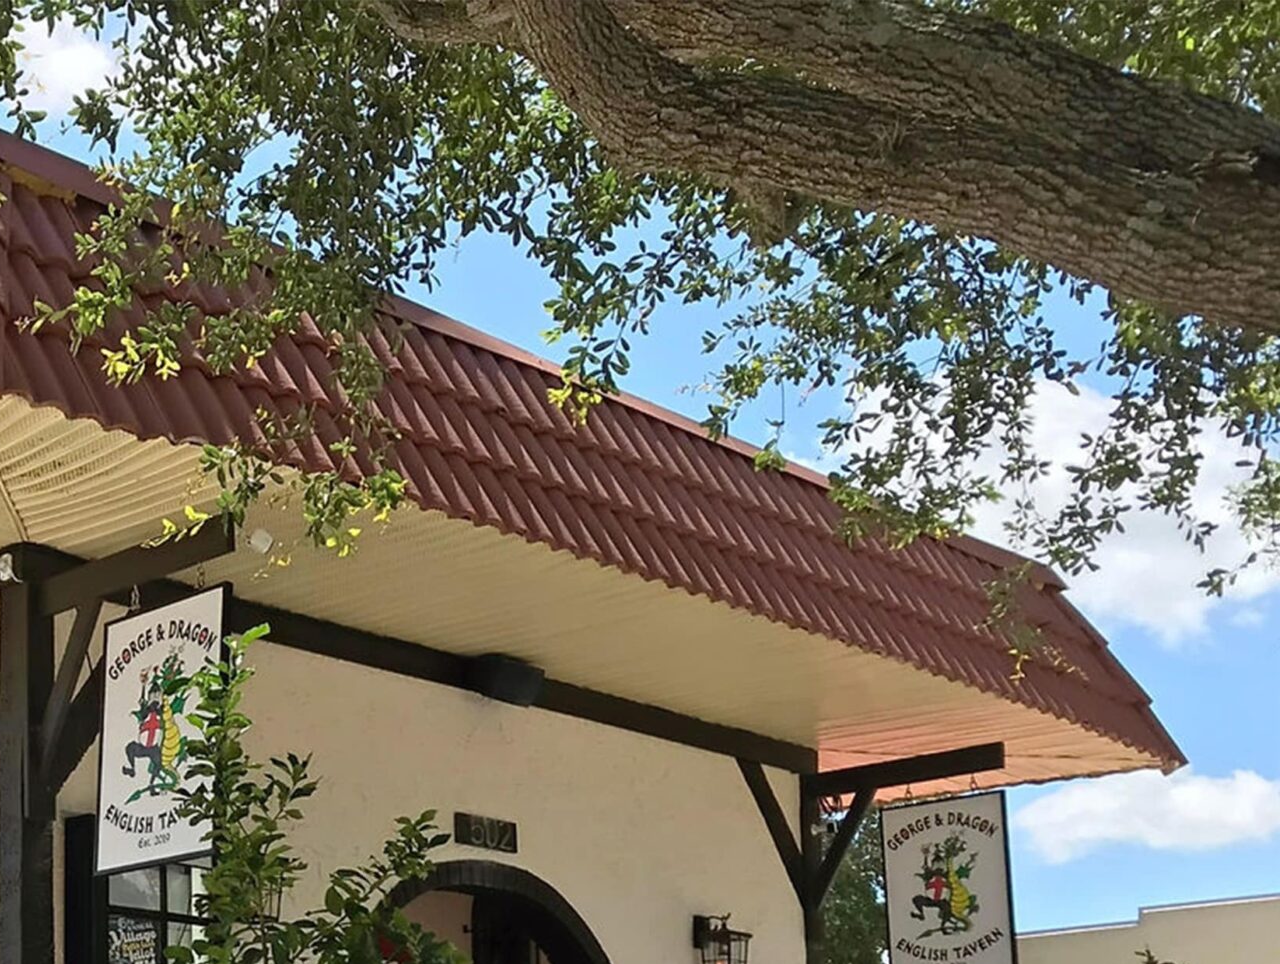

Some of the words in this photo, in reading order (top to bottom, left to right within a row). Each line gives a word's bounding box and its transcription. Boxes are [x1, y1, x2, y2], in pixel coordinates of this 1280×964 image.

[108, 629, 152, 680] GEORGE
[156, 623, 166, 641] &
[170, 620, 217, 652] DRAGON
[103, 804, 154, 834] ENGLISH
[887, 814, 931, 851] GEORGE
[935, 813, 944, 827] &
[947, 812, 999, 838] DRAGON
[896, 938, 948, 961] ENGLISH
[953, 928, 1004, 959] TAVERN
